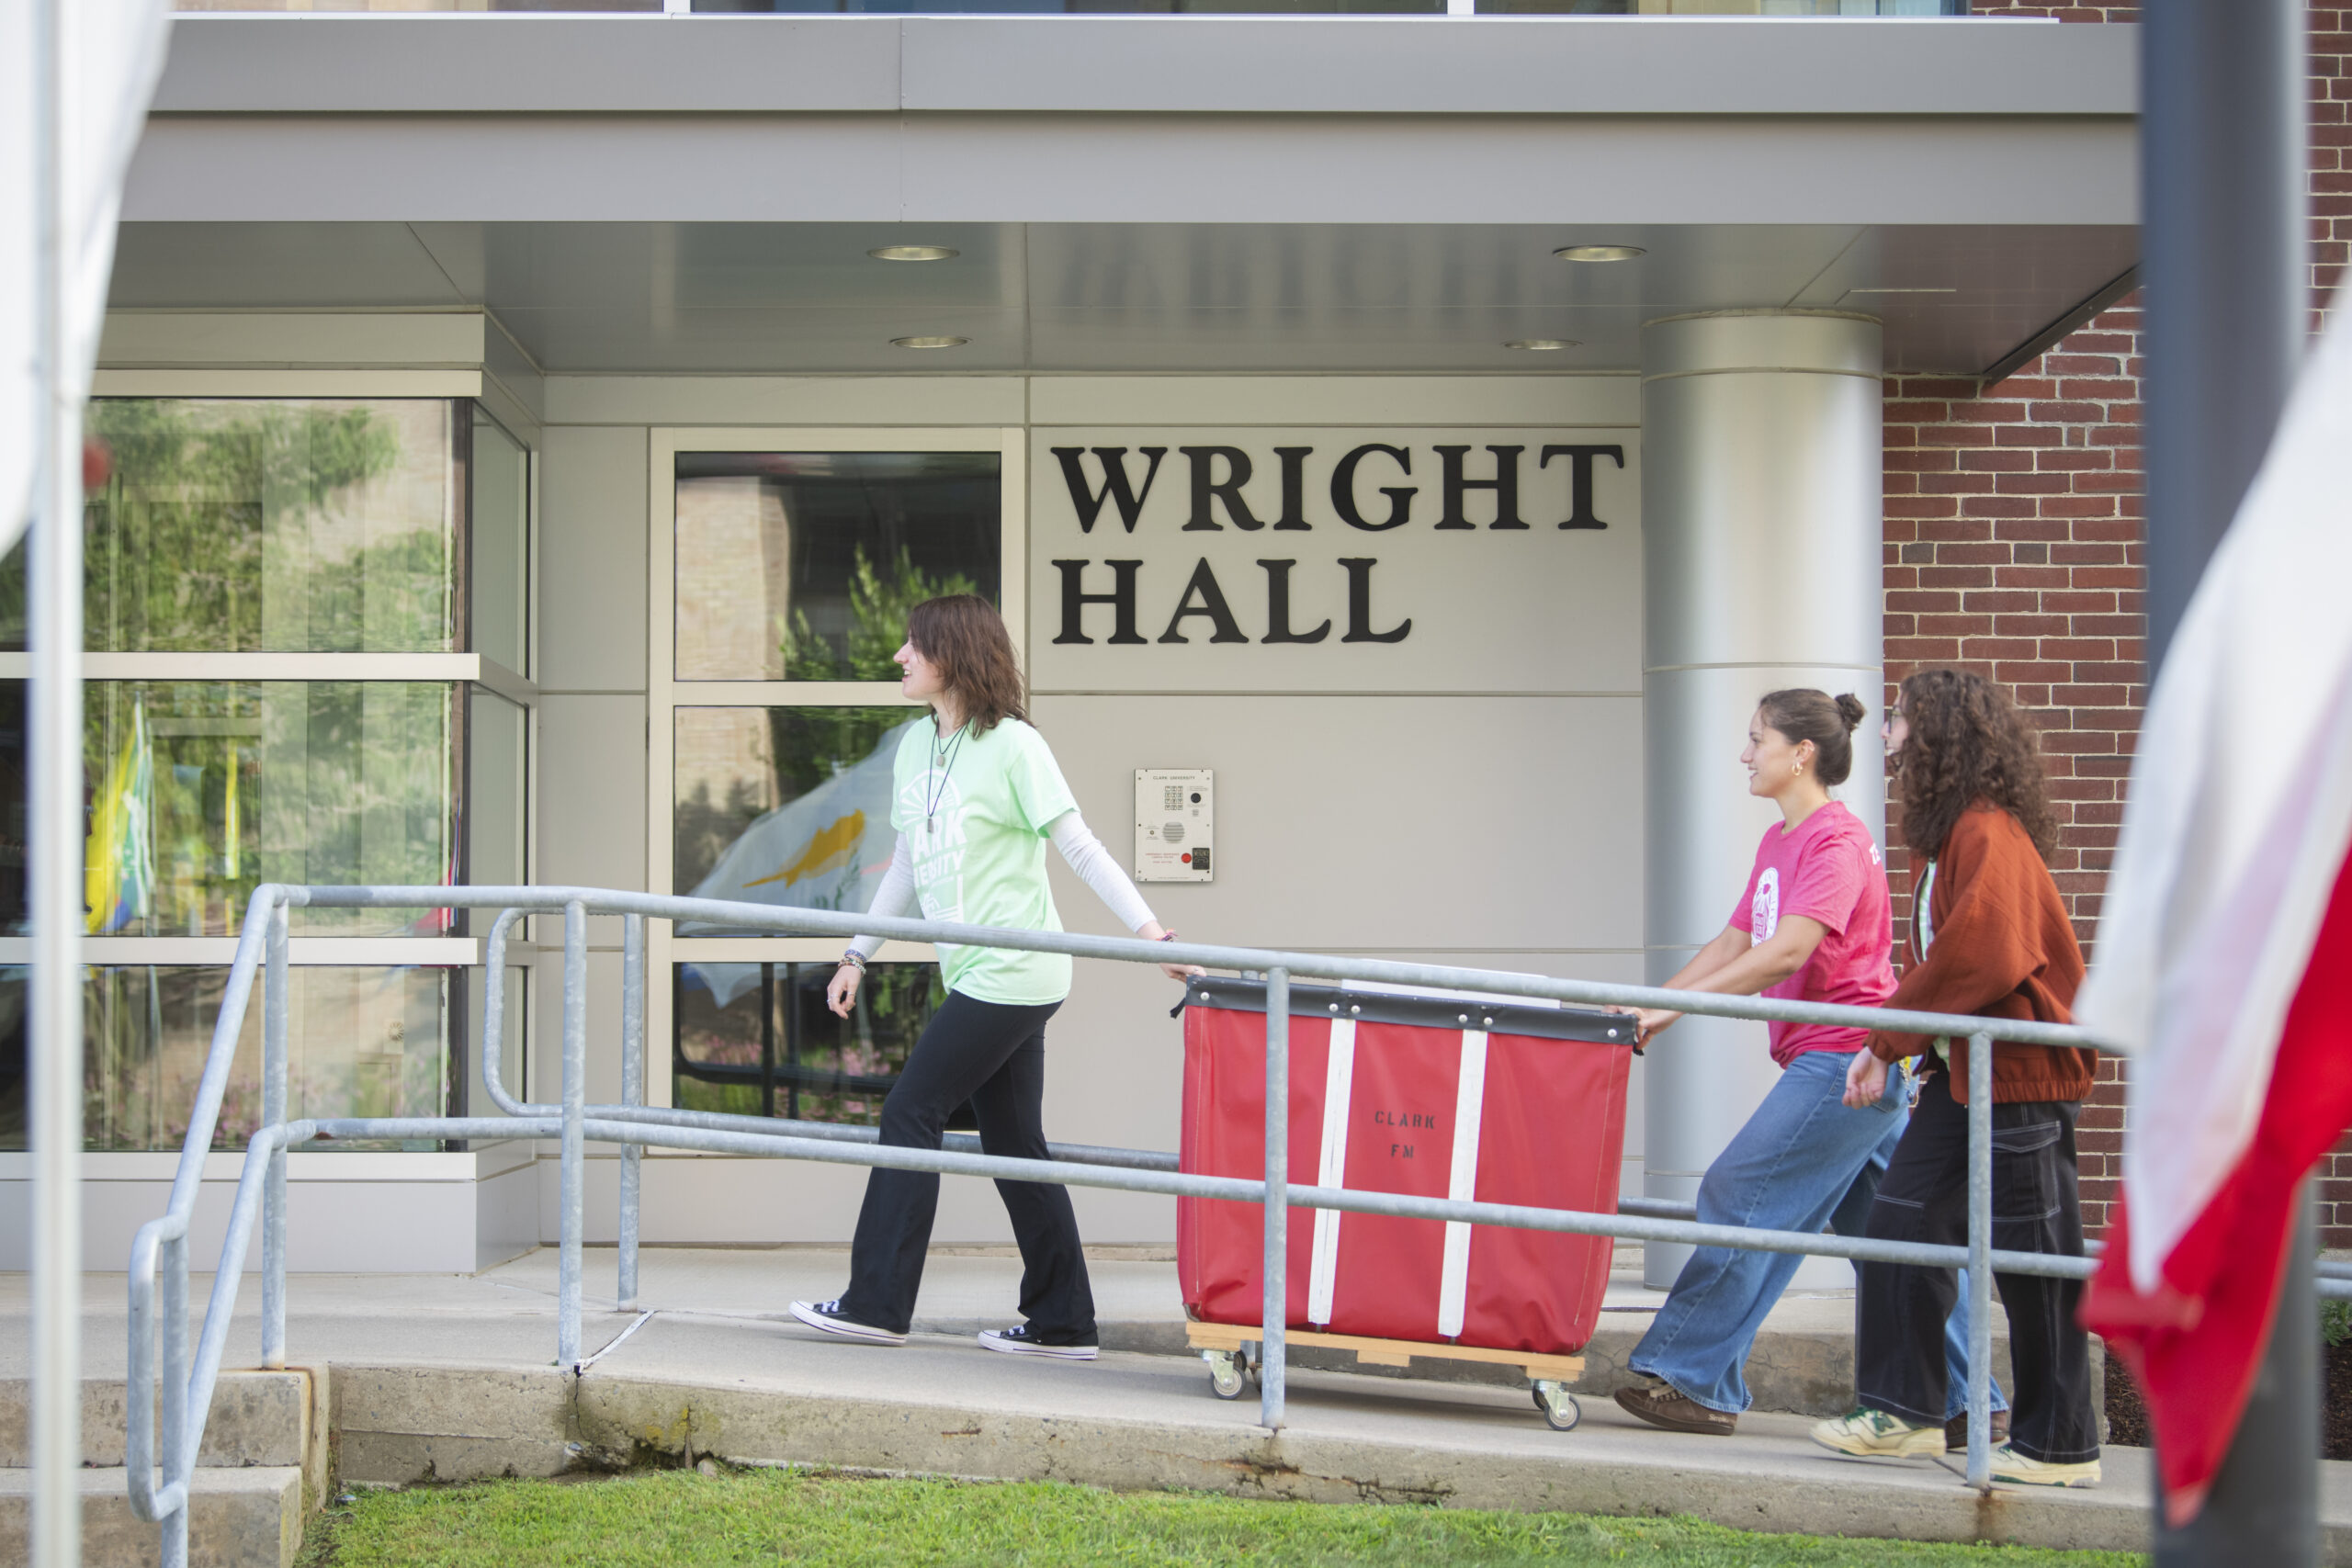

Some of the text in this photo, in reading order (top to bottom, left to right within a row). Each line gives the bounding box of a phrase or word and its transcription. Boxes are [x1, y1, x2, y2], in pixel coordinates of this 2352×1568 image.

[1050, 443, 1624, 534] WRIGHT
[1051, 557, 1412, 645] HALL
[907, 807, 968, 864] ARK
[1374, 1110, 1435, 1130] CLARK
[1390, 1144, 1414, 1159] FM
